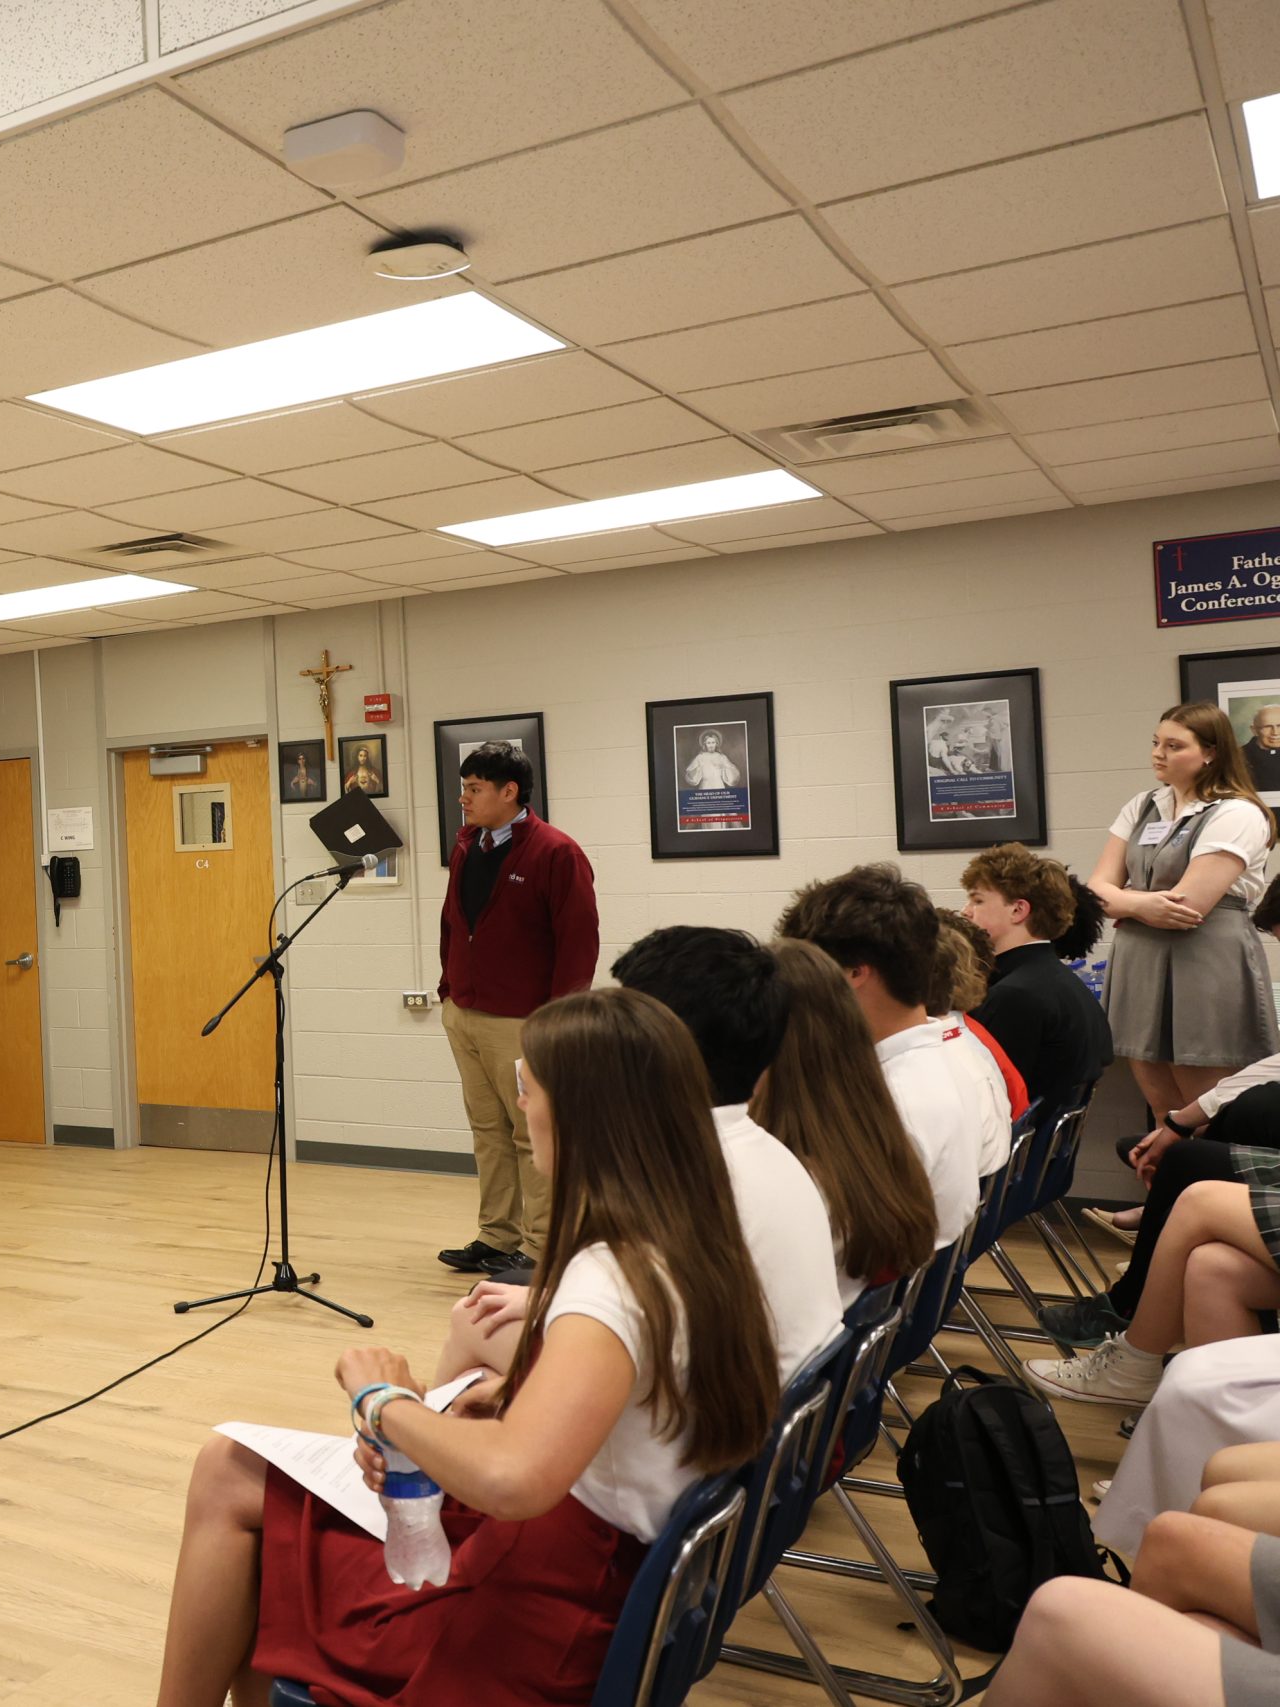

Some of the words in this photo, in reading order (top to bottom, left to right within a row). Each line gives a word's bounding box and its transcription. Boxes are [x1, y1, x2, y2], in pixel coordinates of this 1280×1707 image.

[1232, 552, 1280, 570] Fathe
[1168, 581, 1222, 599] James
[1227, 575, 1247, 589] A.
[1253, 571, 1280, 589] Og
[195, 859, 209, 869] C4
